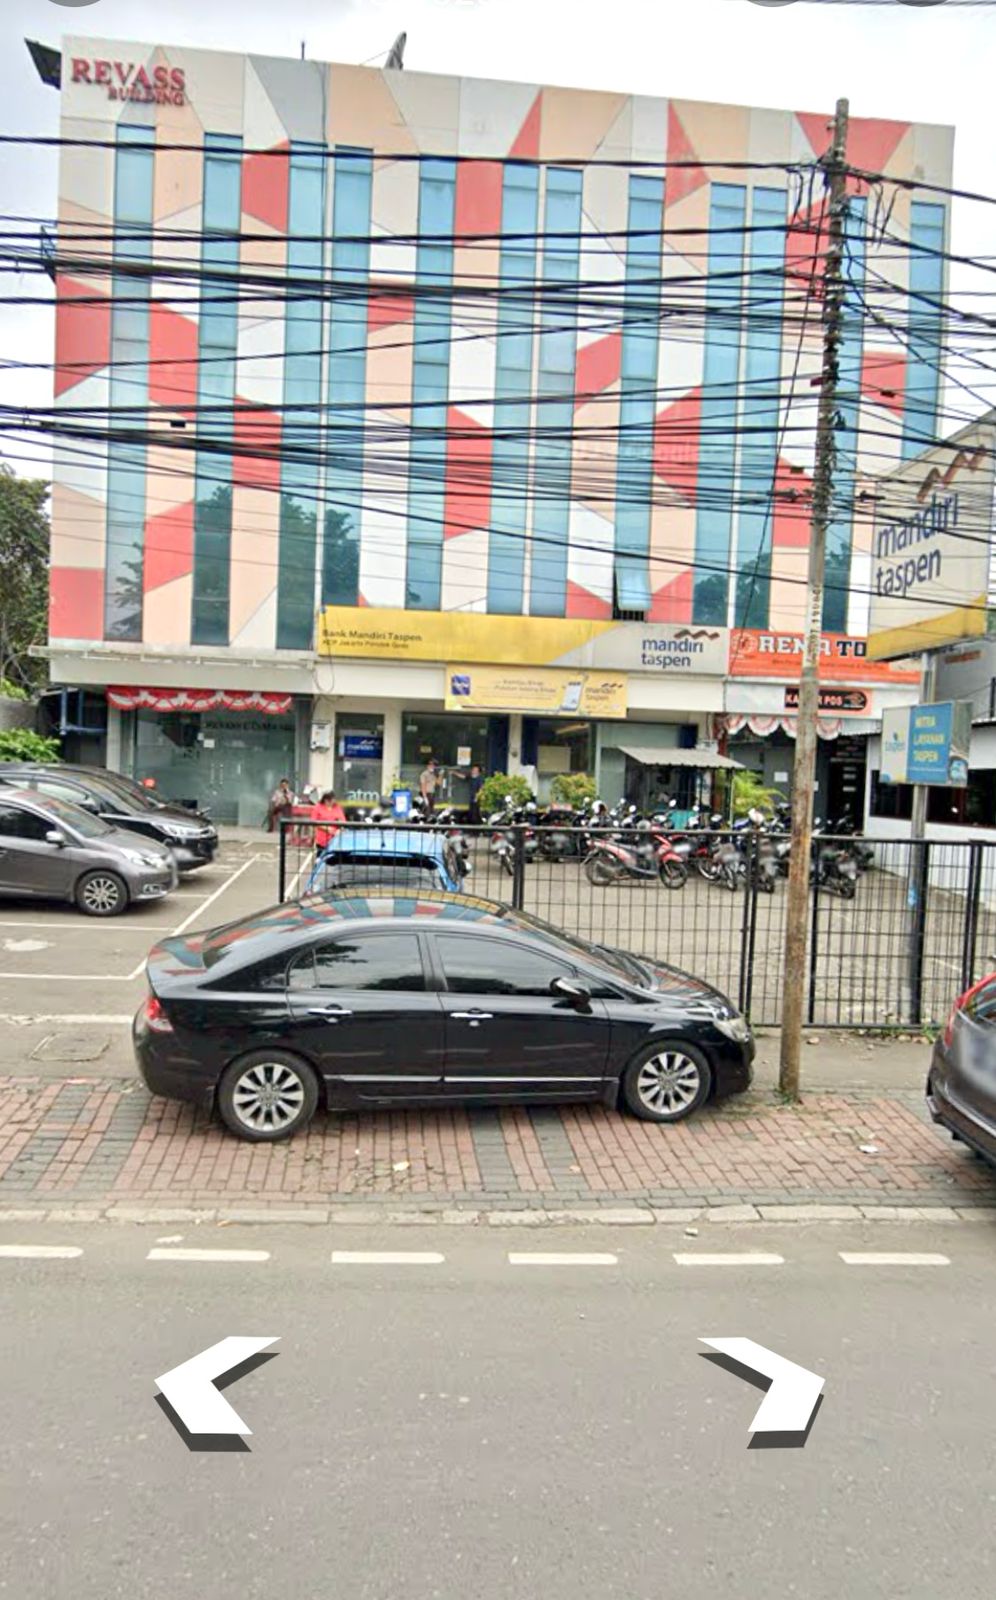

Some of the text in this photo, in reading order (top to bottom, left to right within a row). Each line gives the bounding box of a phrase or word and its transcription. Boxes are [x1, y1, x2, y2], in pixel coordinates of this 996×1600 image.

[71, 58, 185, 91] REVASS
[108, 85, 185, 106] BUILDING
[877, 493, 959, 559] mandiri
[876, 548, 941, 597] taspen
[322, 629, 423, 642] Bank Mandiri Taspen
[642, 638, 704, 653] mandiri
[641, 653, 691, 669] taspen
[824, 695, 843, 706] POS
[347, 790, 380, 801] atm
